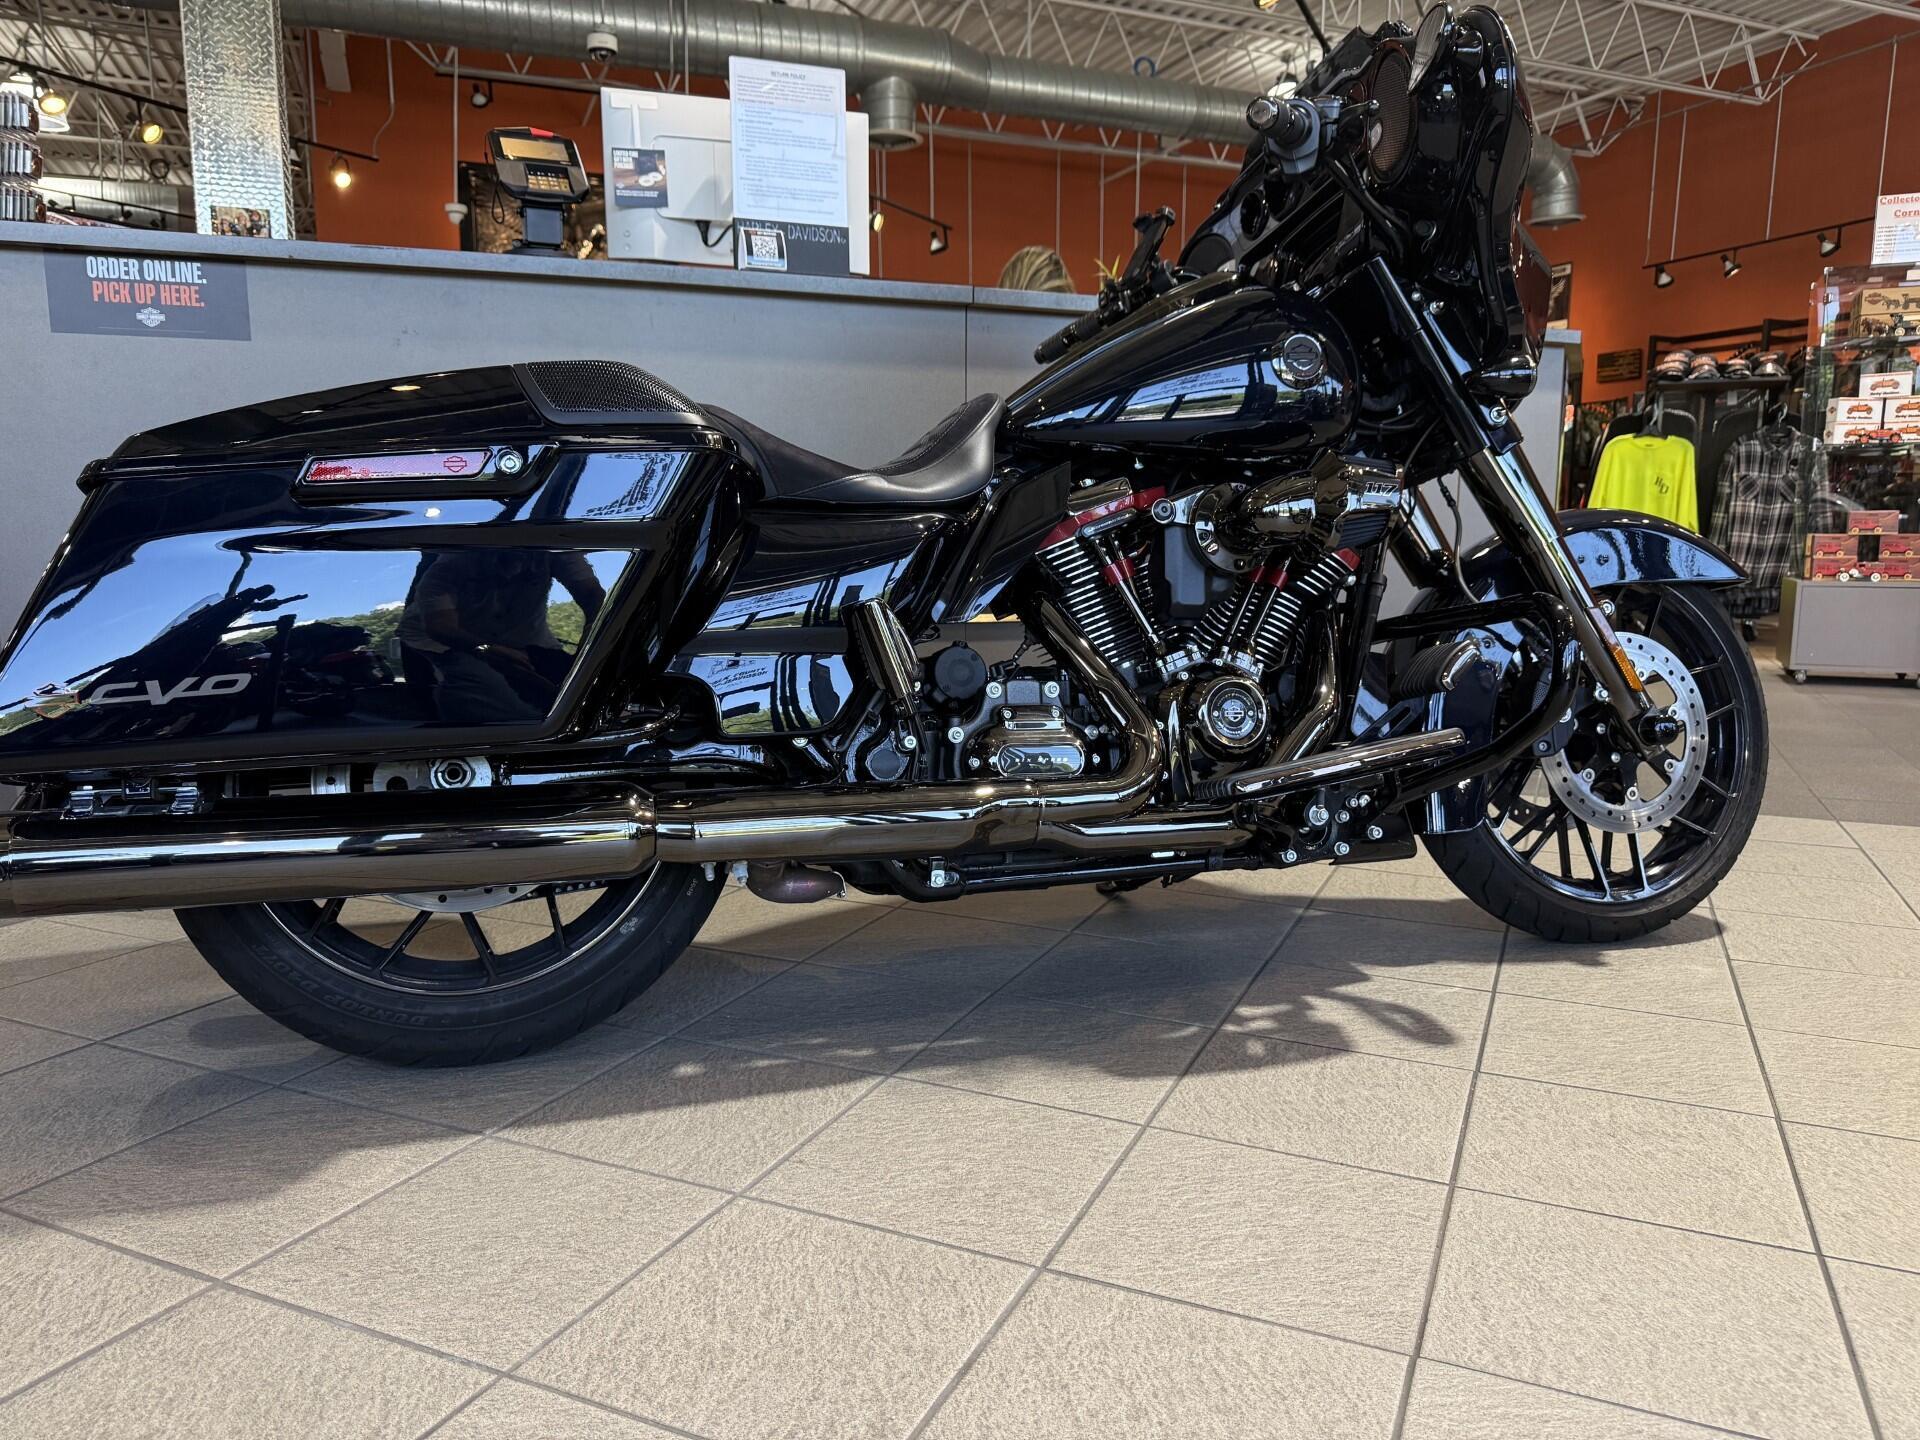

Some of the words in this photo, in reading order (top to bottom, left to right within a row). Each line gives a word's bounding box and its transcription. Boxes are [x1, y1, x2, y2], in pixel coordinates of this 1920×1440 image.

[787, 223, 840, 245] DAVIDSON
[86, 255, 140, 281] ORDER
[143, 259, 207, 284] ONLINE.
[92, 280, 132, 303] PICK
[134, 282, 156, 304] UP
[160, 284, 205, 307] HERE.
[1363, 481, 1399, 497] 117
[90, 672, 252, 706] CVO
[321, 994, 430, 1026] DUNLOP
